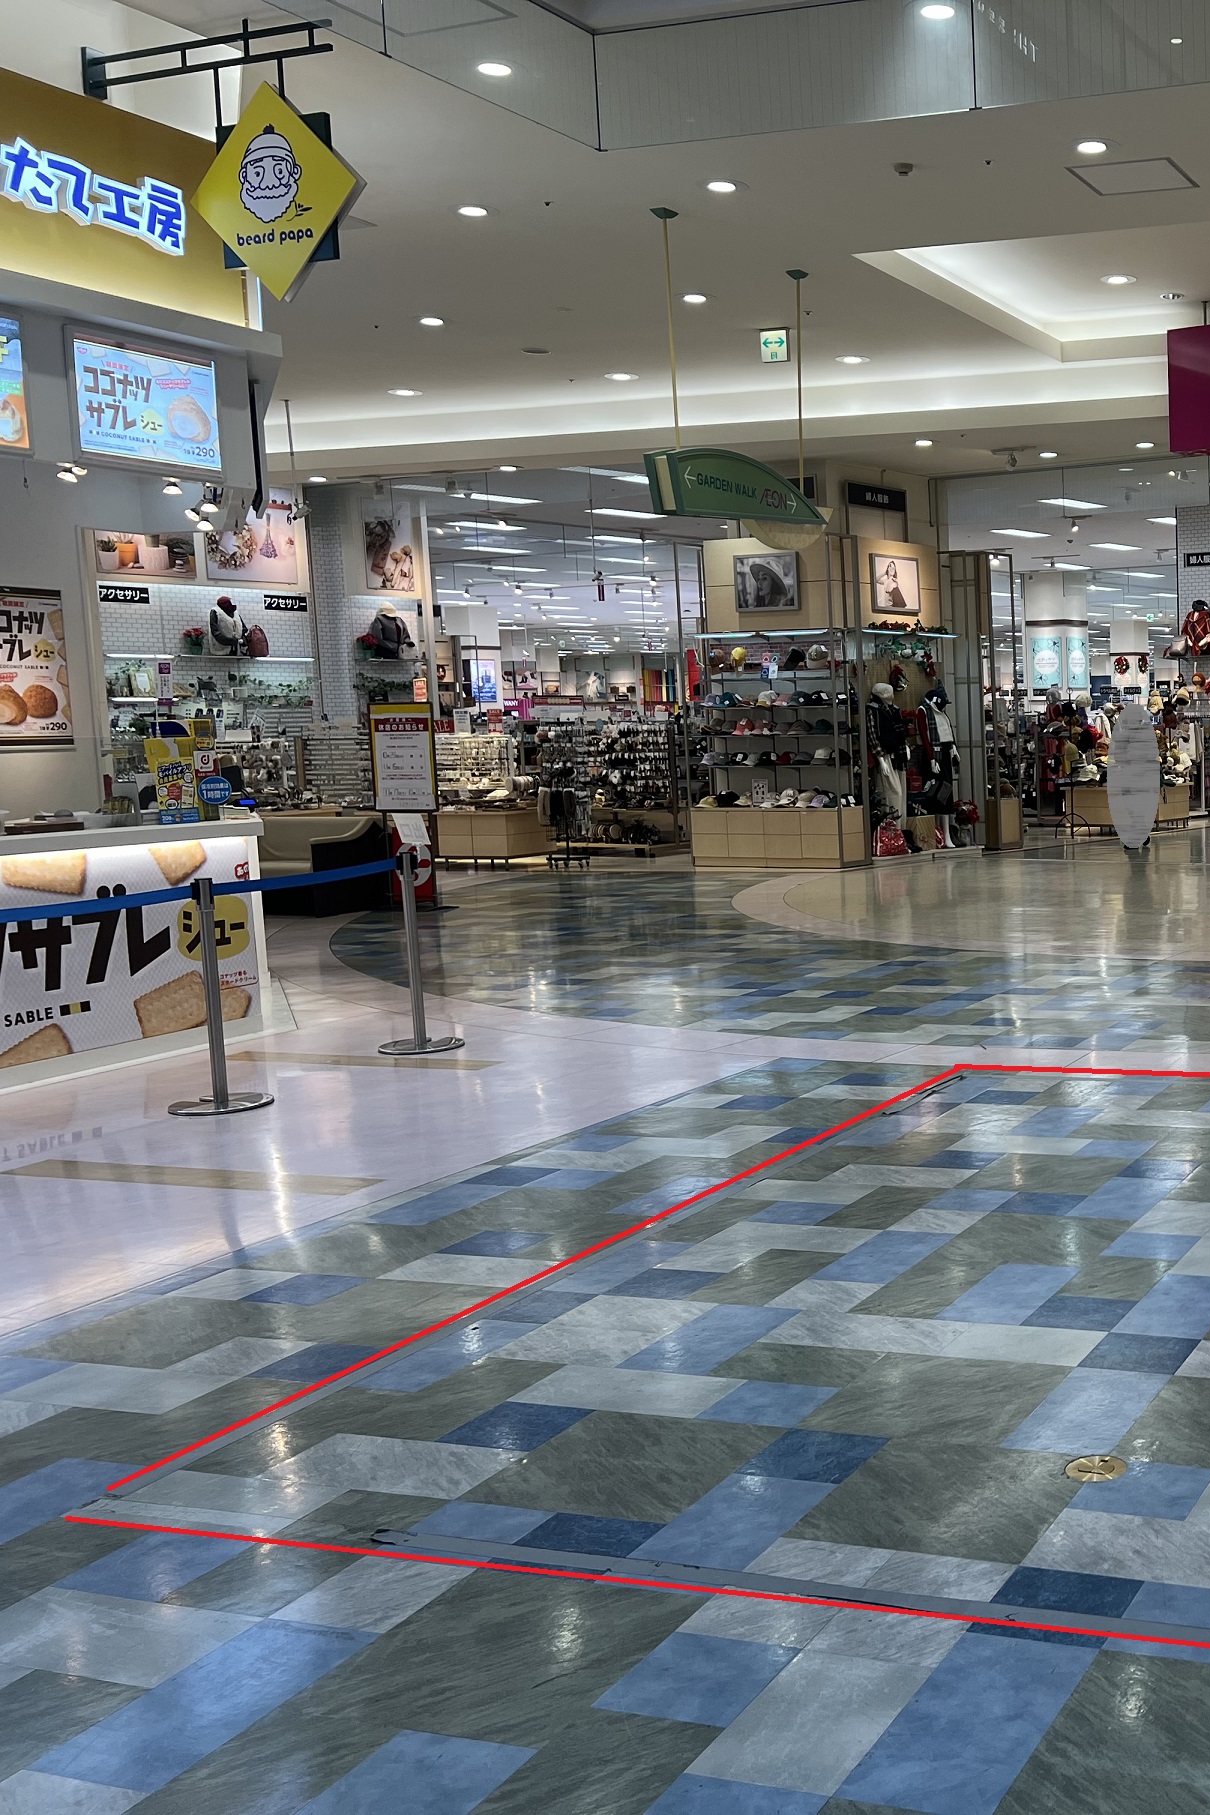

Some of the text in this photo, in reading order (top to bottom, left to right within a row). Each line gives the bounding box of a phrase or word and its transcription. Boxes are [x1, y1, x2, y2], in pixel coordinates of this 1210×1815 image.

[236, 227, 314, 247] beard papa
[83, 365, 152, 403] ココナッツ
[86, 397, 137, 431] サブレ
[140, 414, 163, 431] シュー
[696, 472, 733, 493] GARDEN
[733, 482, 757, 499] WALK
[99, 589, 148, 600] アクセサリー
[264, 596, 306, 608] アクセサリー
[0, 634, 32, 662] ブレ
[34, 645, 55, 659] シュー
[202, 790, 230, 799] 1時間です
[0, 883, 171, 992] サブレ
[219, 970, 248, 980] コナッツ香る
[220, 975, 257, 987] スタードクリーム
[4, 1006, 54, 1028] SABLE
